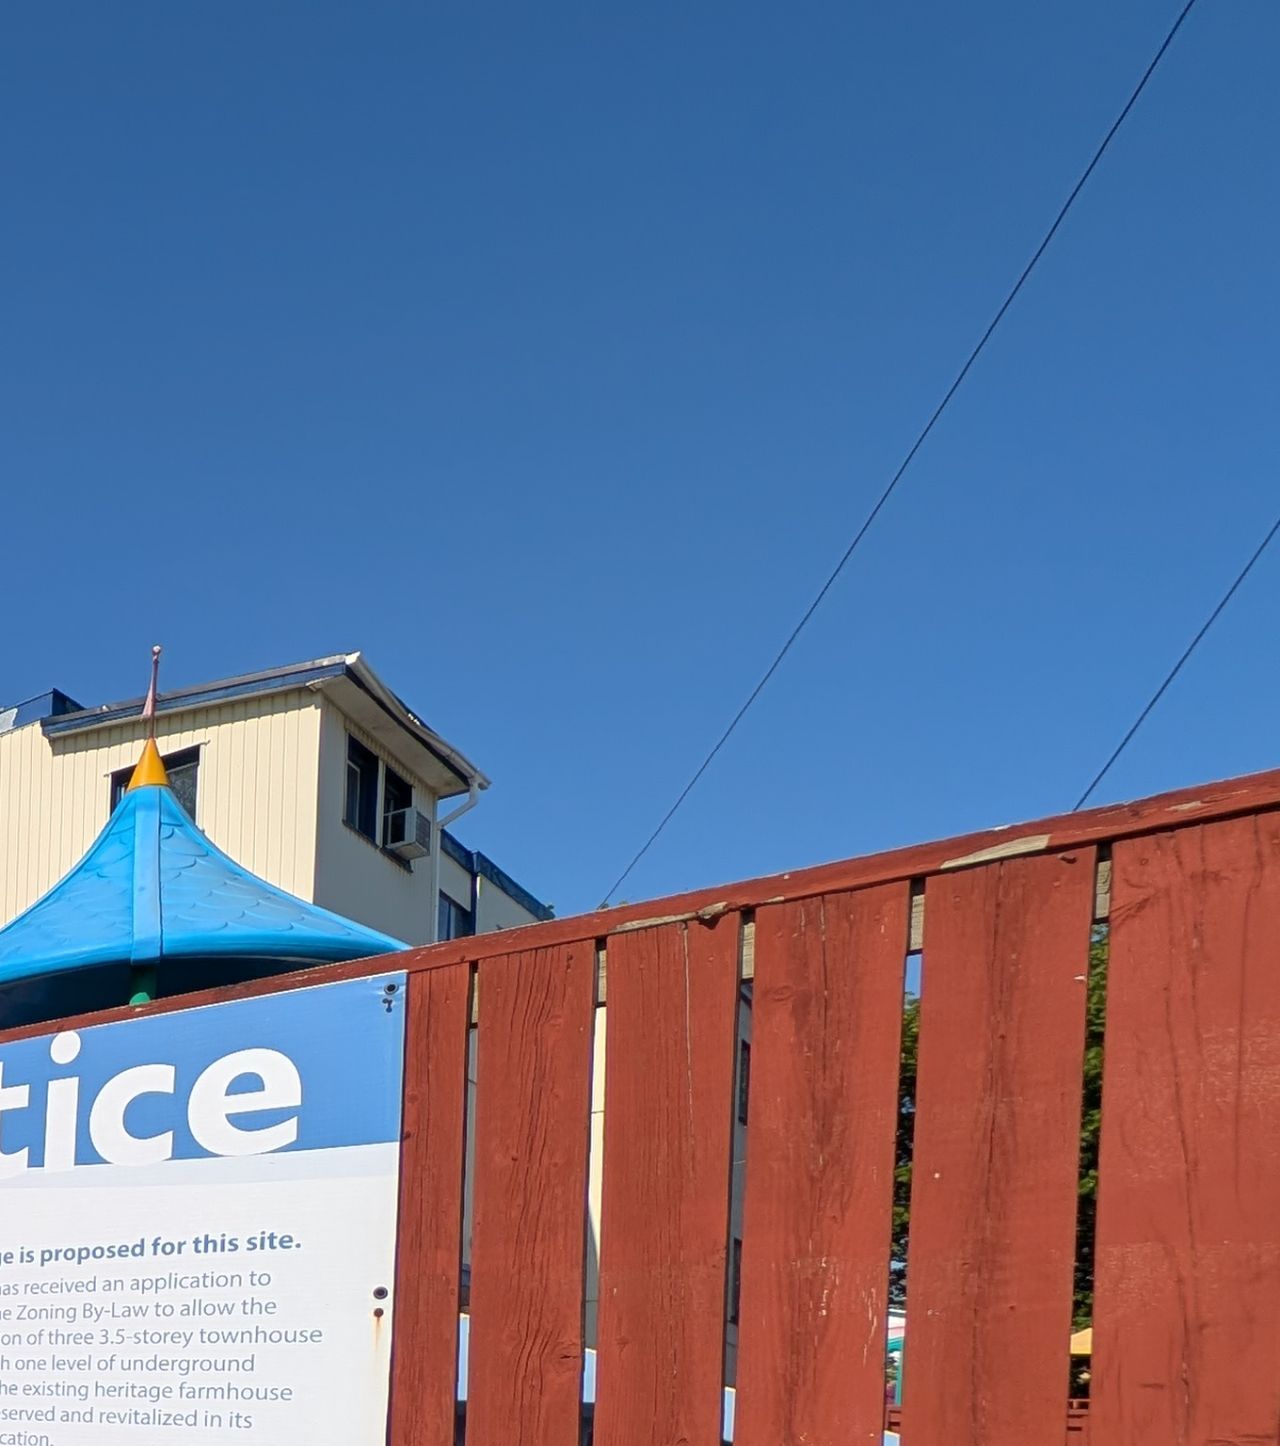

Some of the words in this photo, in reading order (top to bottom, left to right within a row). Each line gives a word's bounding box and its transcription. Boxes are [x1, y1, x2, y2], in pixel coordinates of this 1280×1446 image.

[19, 1246, 35, 1264] is
[40, 1237, 146, 1267] proposed
[151, 1236, 187, 1256] for
[192, 1232, 240, 1255] this
[246, 1230, 302, 1252] site.
[23, 1275, 97, 1295] received
[102, 1279, 124, 1293] an
[130, 1271, 242, 1295] application
[249, 1271, 272, 1287] to
[16, 1303, 77, 1324] Zoning
[82, 1302, 149, 1322] By-Law
[154, 1302, 175, 1317] to
[179, 1299, 235, 1317] allow
[241, 1297, 278, 1316] the
[26, 1329, 45, 1346] of
[48, 1329, 95, 1345] three
[99, 1328, 194, 1349] 3.5-storey
[199, 1325, 324, 1344] townhouse
[15, 1358, 47, 1371] one
[51, 1355, 92, 1371] level
[97, 1354, 116, 1371] of
[120, 1354, 256, 1376] underground
[22, 1381, 89, 1401] existing
[95, 1381, 173, 1403] heritage
[178, 1382, 293, 1401] farmhouse
[60, 1407, 94, 1423] and
[99, 1408, 198, 1426] revitalized
[204, 1411, 222, 1428] in
[229, 1411, 253, 1429] its
